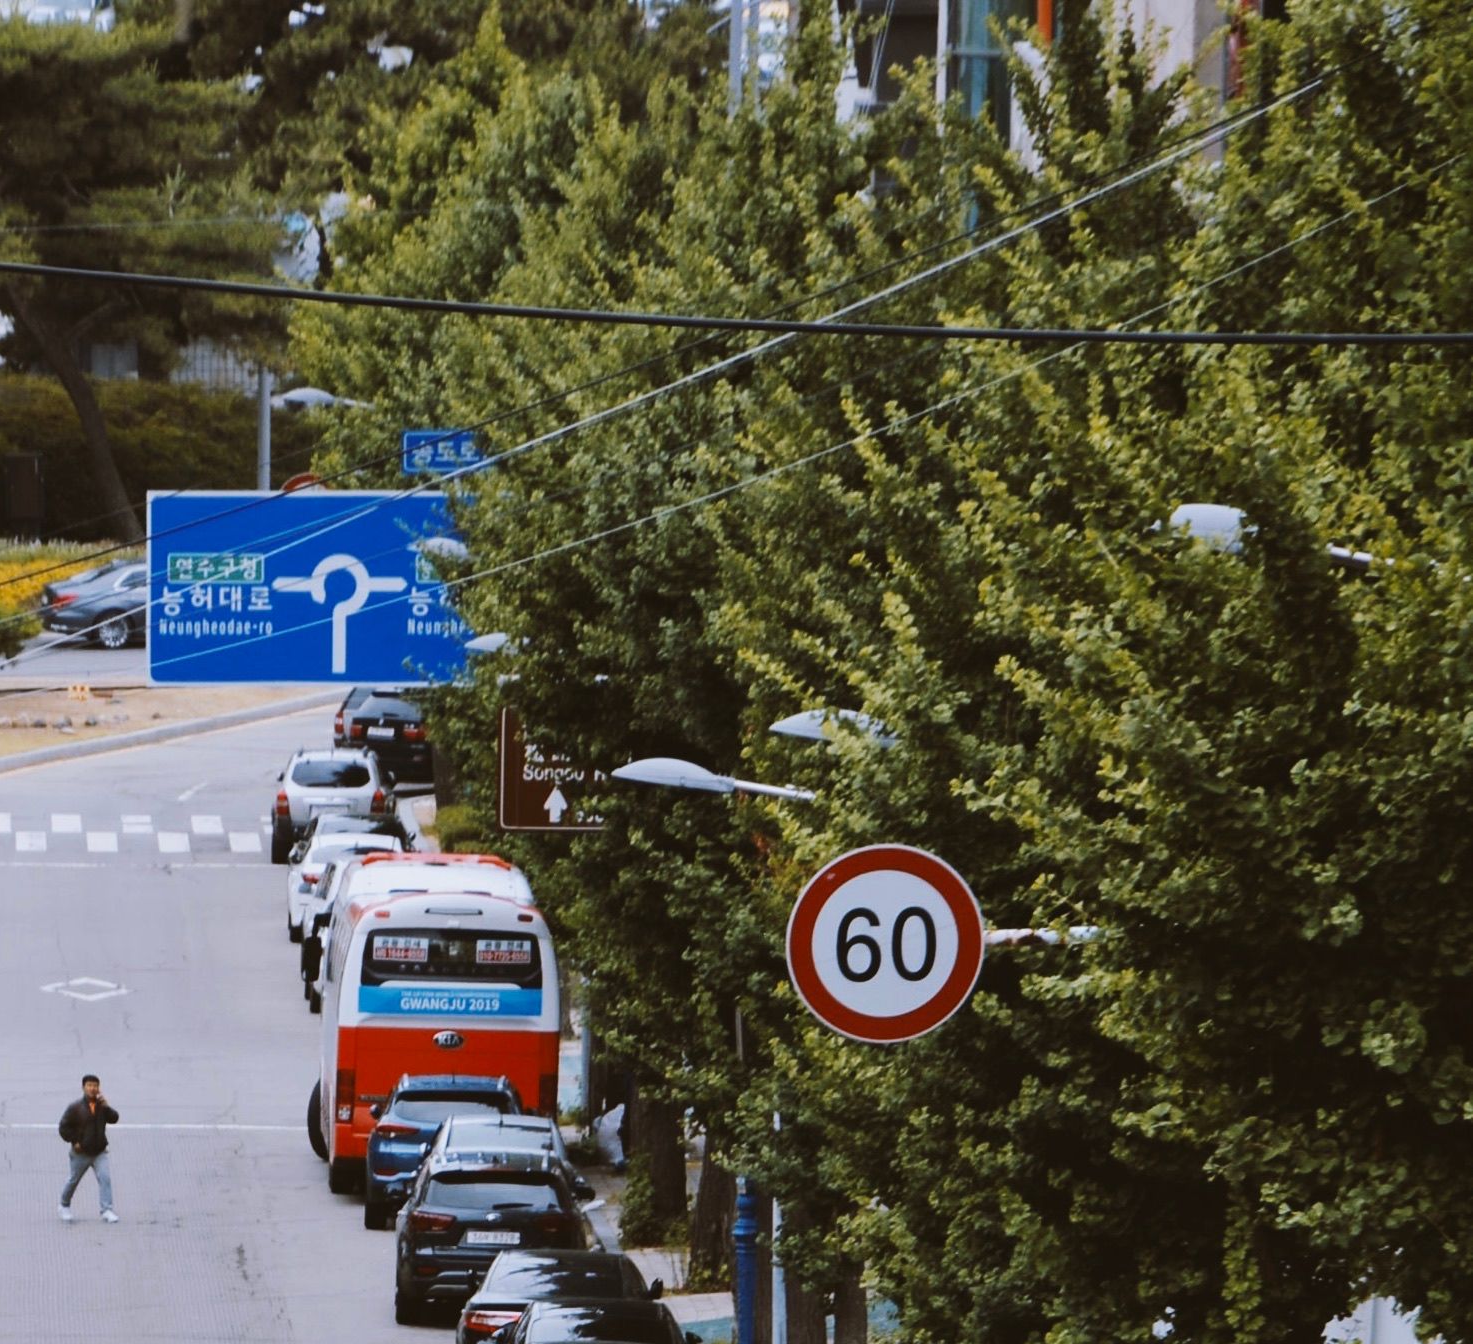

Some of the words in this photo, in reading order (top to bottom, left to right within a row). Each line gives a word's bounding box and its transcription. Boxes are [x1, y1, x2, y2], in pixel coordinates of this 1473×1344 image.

[159, 585, 273, 616] 능허대로
[159, 617, 273, 639] Neungheodae-ro
[836, 906, 937, 983] 60
[400, 997, 466, 1011] GWANGJU
[468, 998, 500, 1012] 2019
